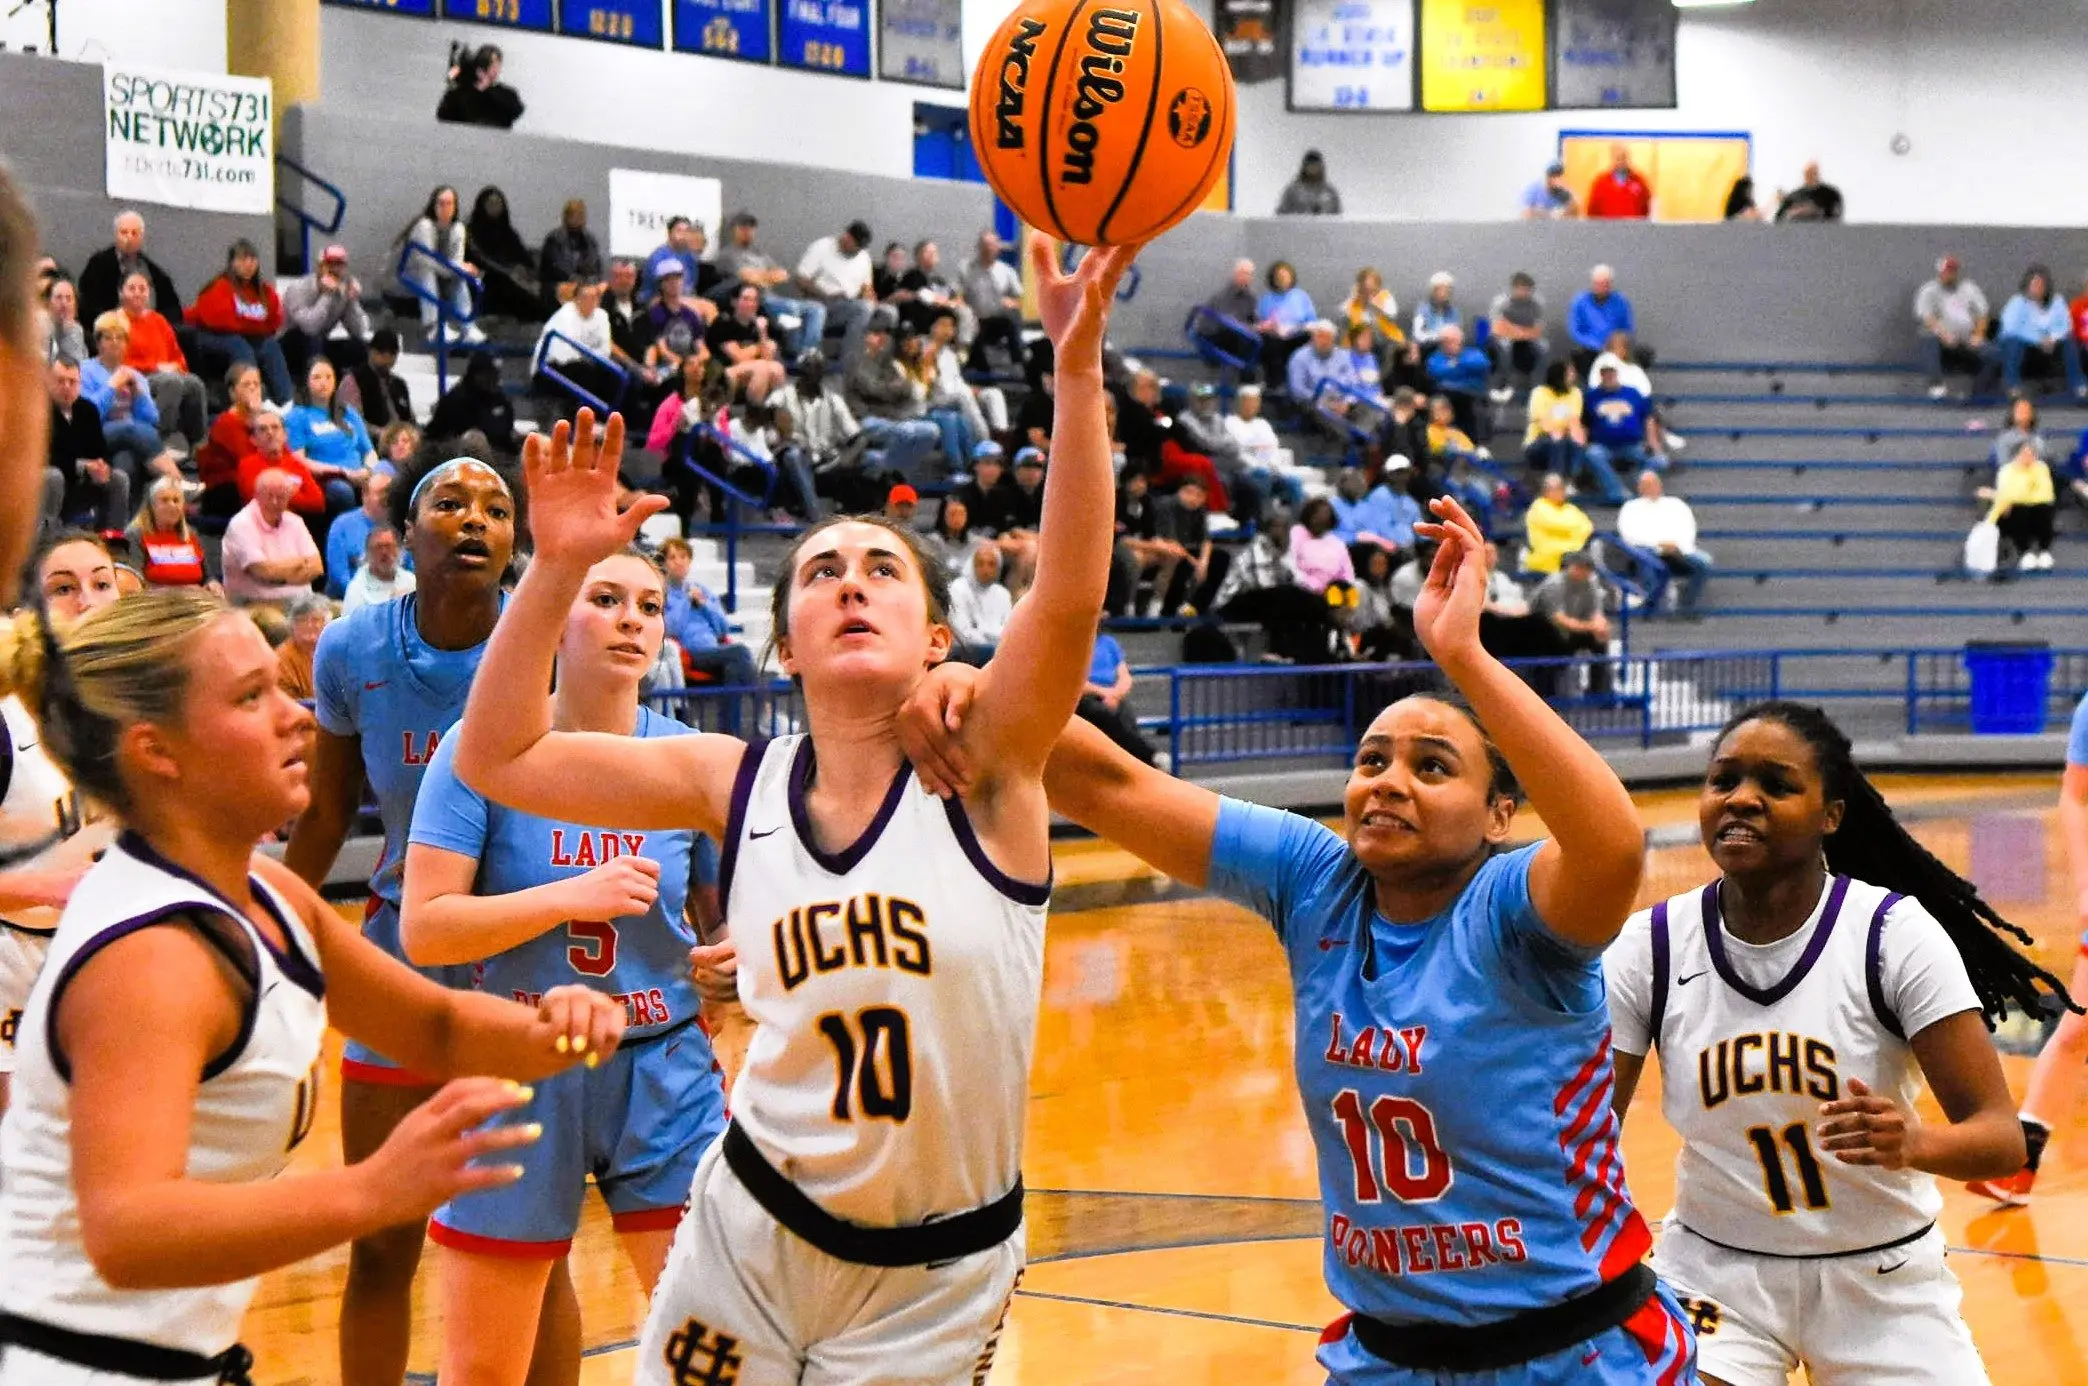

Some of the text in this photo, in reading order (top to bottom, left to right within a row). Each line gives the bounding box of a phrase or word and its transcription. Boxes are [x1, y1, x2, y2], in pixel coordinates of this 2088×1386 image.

[110, 72, 268, 123] SPORTS731
[995, 17, 1047, 149] NCAA
[1061, 8, 1142, 185] Wilson
[110, 108, 266, 158] NETWORK
[403, 730, 442, 765] LA
[551, 829, 645, 868] LADY
[567, 918, 619, 977] 5
[772, 892, 932, 992] UCHS
[815, 1005, 914, 1125] 10
[1325, 1012, 1428, 1076] LADY
[1699, 1031, 1839, 1110] UCHS
[1331, 1089, 1453, 1204] 10
[1744, 1119, 1832, 1216] 11
[1331, 1213, 1528, 1276] PONEERS
